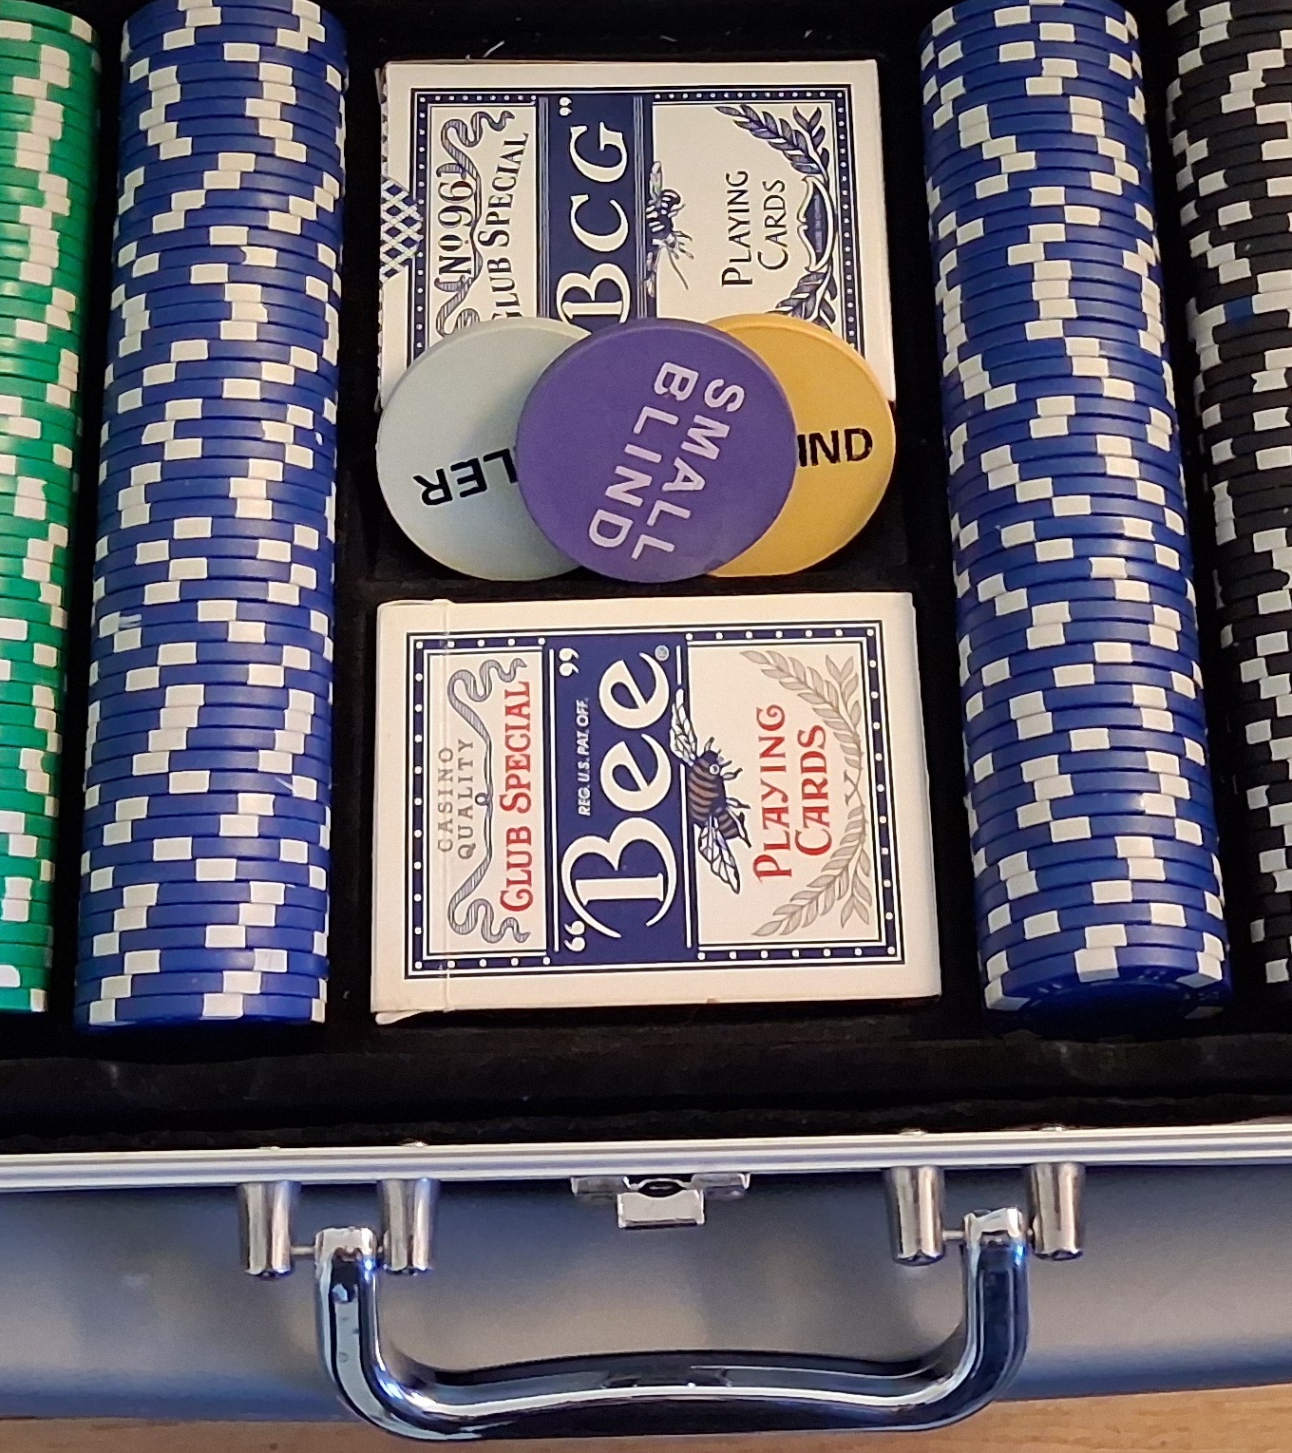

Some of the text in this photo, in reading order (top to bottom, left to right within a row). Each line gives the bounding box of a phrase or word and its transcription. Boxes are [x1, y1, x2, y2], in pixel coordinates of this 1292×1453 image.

[477, 132, 529, 247] SPECIAL
[721, 169, 753, 287] PLAYING
[757, 178, 789, 270] CARDS
[588, 361, 700, 549] BLIND
[630, 378, 746, 560] SMALL
[438, 747, 454, 853] CASINO
[458, 739, 475, 861] QUALITY
[499, 681, 534, 912] CLUB SPECIAL
[751, 704, 792, 884] PLAYING
[793, 724, 833, 857] CARDS
